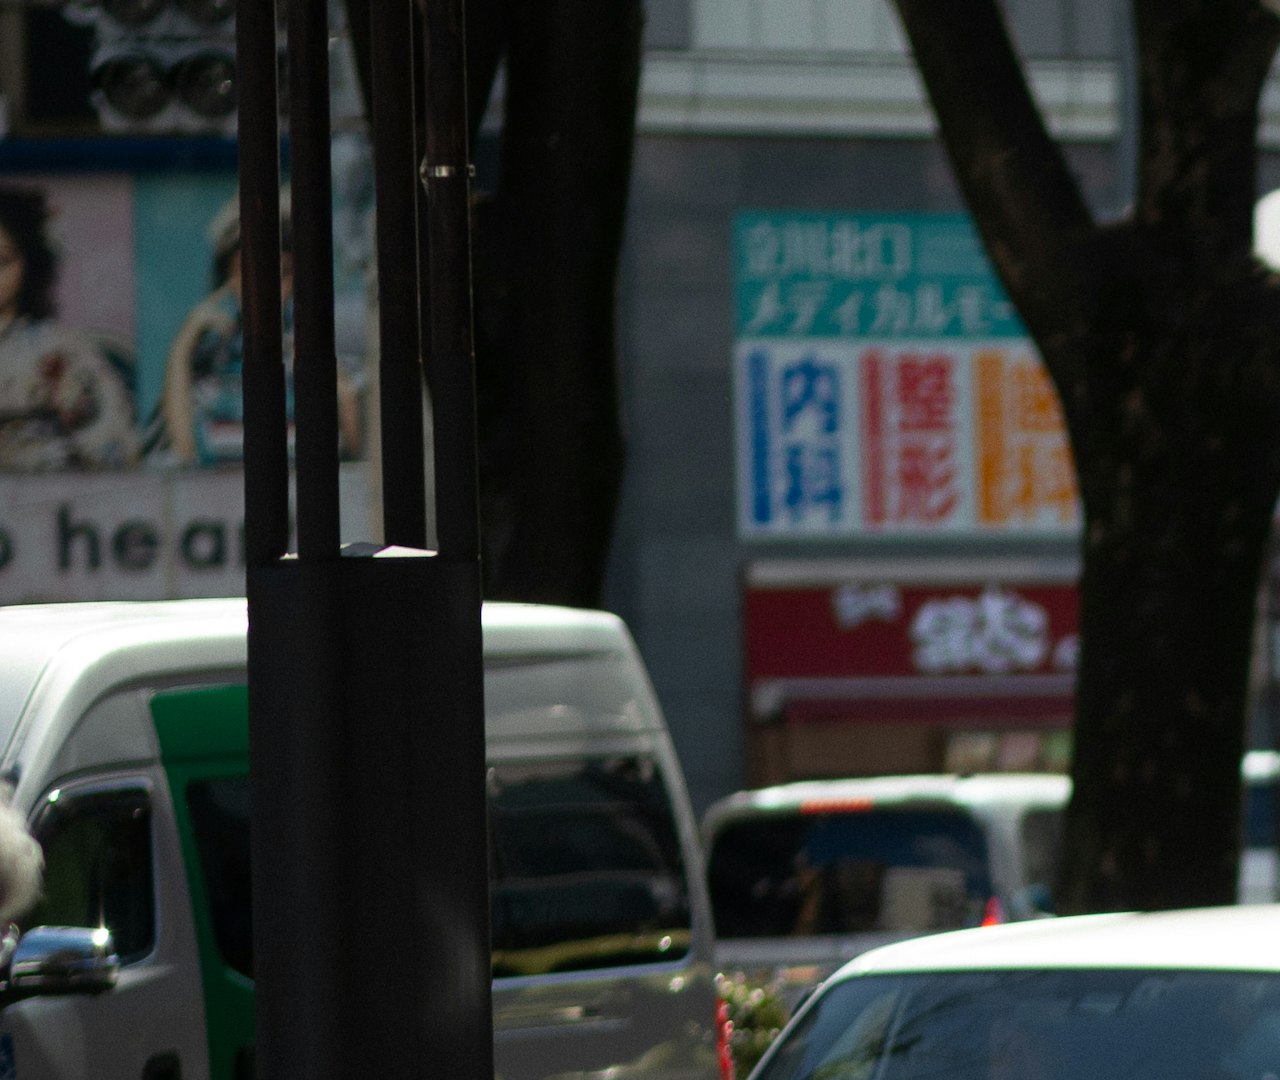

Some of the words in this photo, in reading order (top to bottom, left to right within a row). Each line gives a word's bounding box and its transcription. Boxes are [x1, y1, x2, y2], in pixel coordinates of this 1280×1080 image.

[746, 221, 911, 278] 立川北口
[781, 352, 845, 524] 内科
[895, 353, 962, 526] 整形
[55, 502, 247, 574] hea
